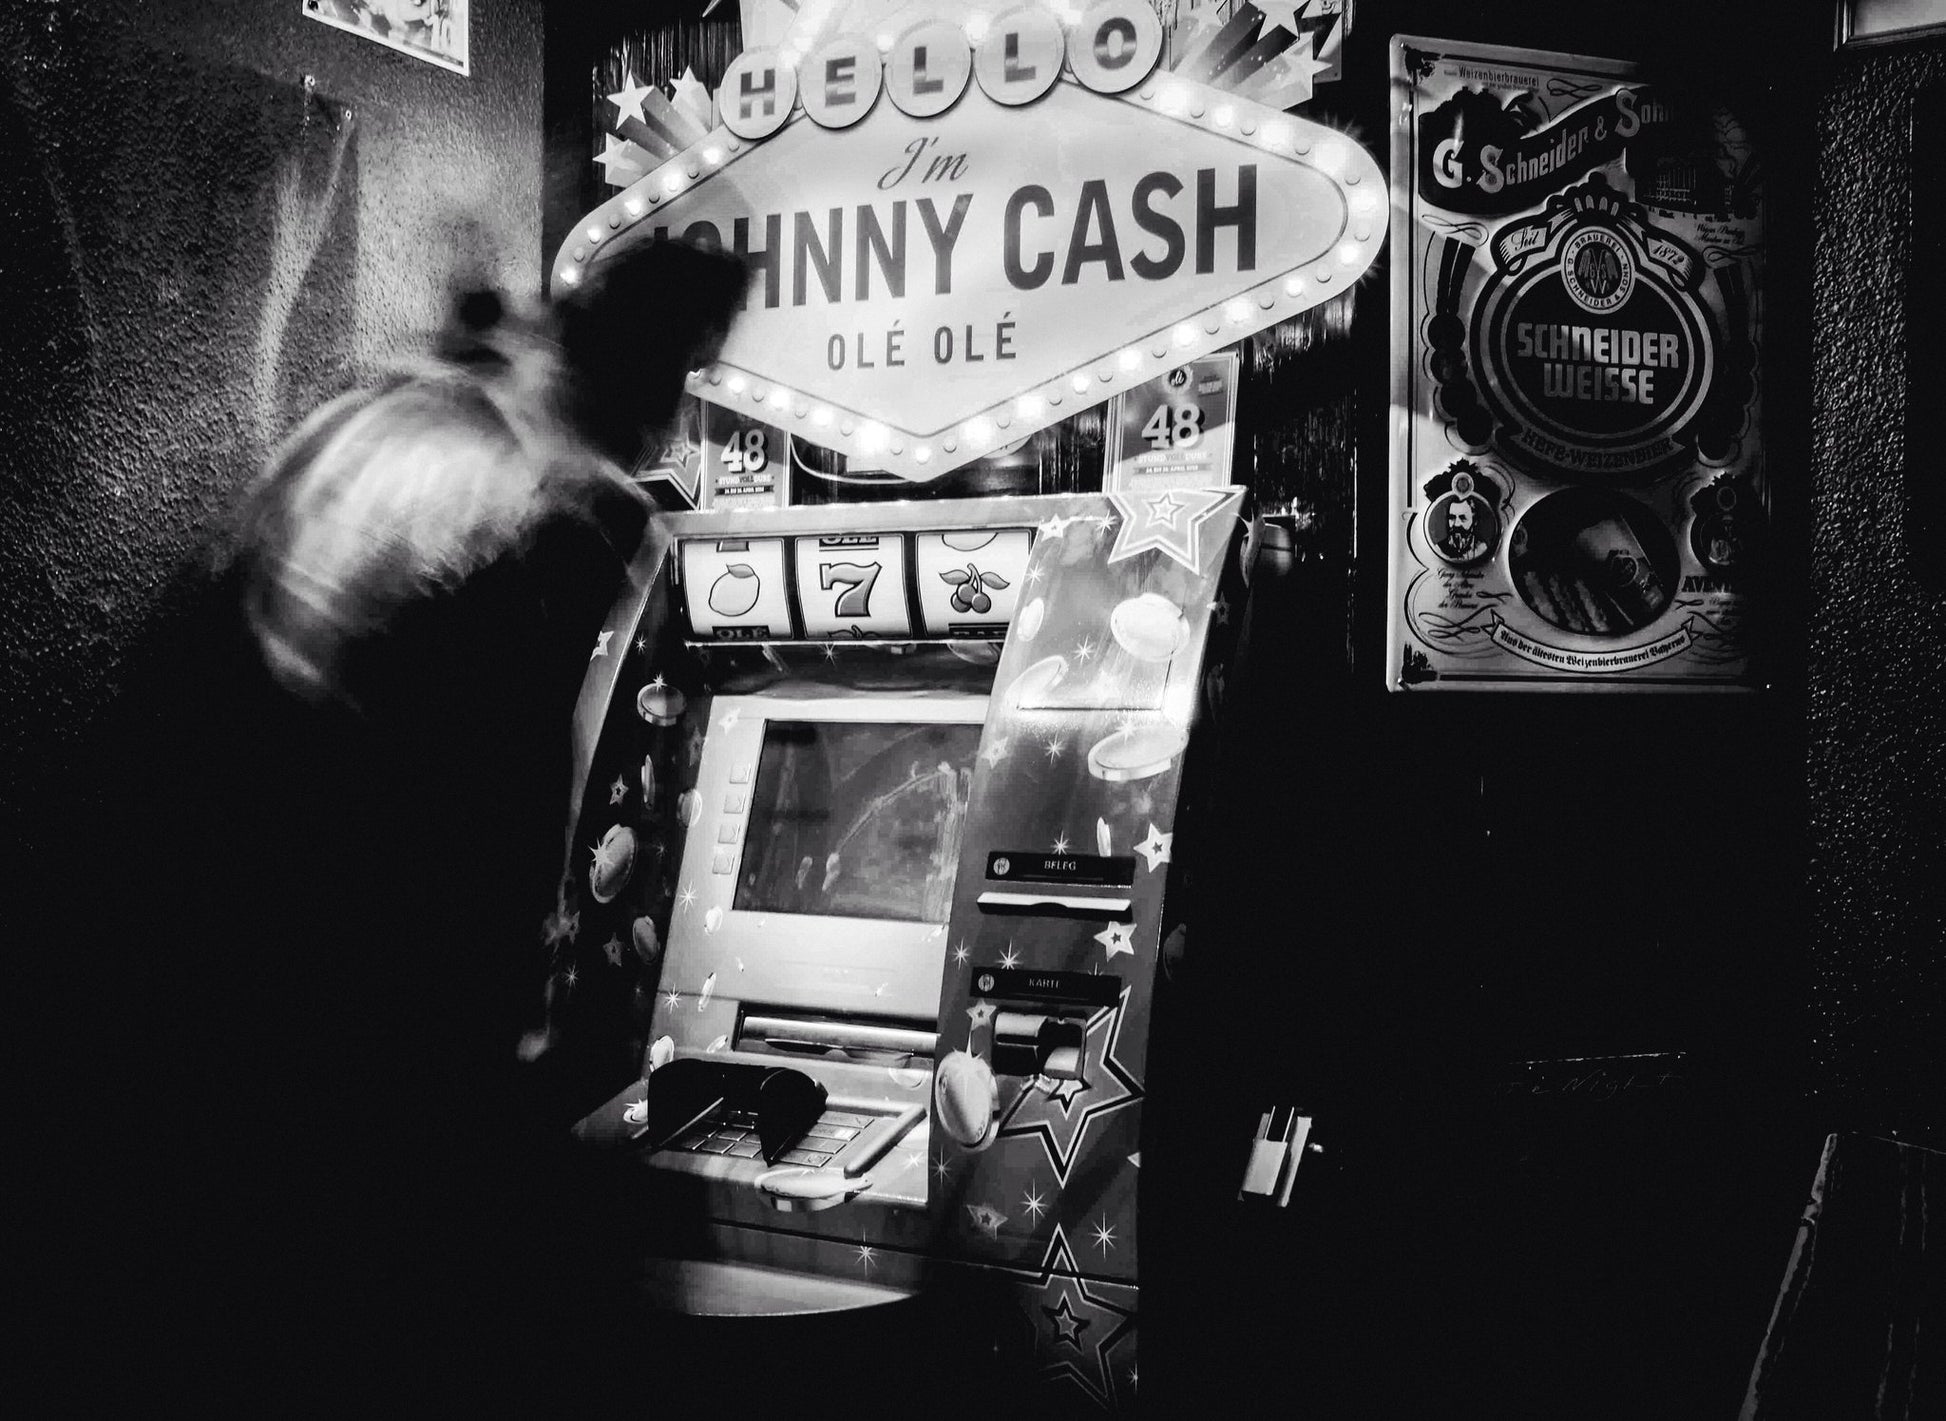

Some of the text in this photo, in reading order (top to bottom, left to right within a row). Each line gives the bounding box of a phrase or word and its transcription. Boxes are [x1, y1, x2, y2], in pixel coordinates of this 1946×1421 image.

[740, 17, 1137, 119] HELLO
[1476, 125, 1589, 194] Schneider
[1595, 115, 1607, 140] &
[1614, 89, 1673, 138] Soh
[654, 165, 1258, 312] HNNY CASH
[1574, 233, 1622, 253] BRAUEREI
[827, 312, 1018, 371] OLÉ OLÉ
[1517, 322, 1679, 369] SCHNEIDER
[1543, 362, 1654, 405] WEISSE
[1141, 402, 1205, 450] 48
[720, 428, 768, 473] 48
[1500, 628, 1518, 647] Aus
[1518, 638, 1532, 654] der
[1532, 643, 1565, 664] ältesten
[1566, 650, 1650, 669] Weizenbierbrauerei
[1044, 860, 1076, 871] BELEG
